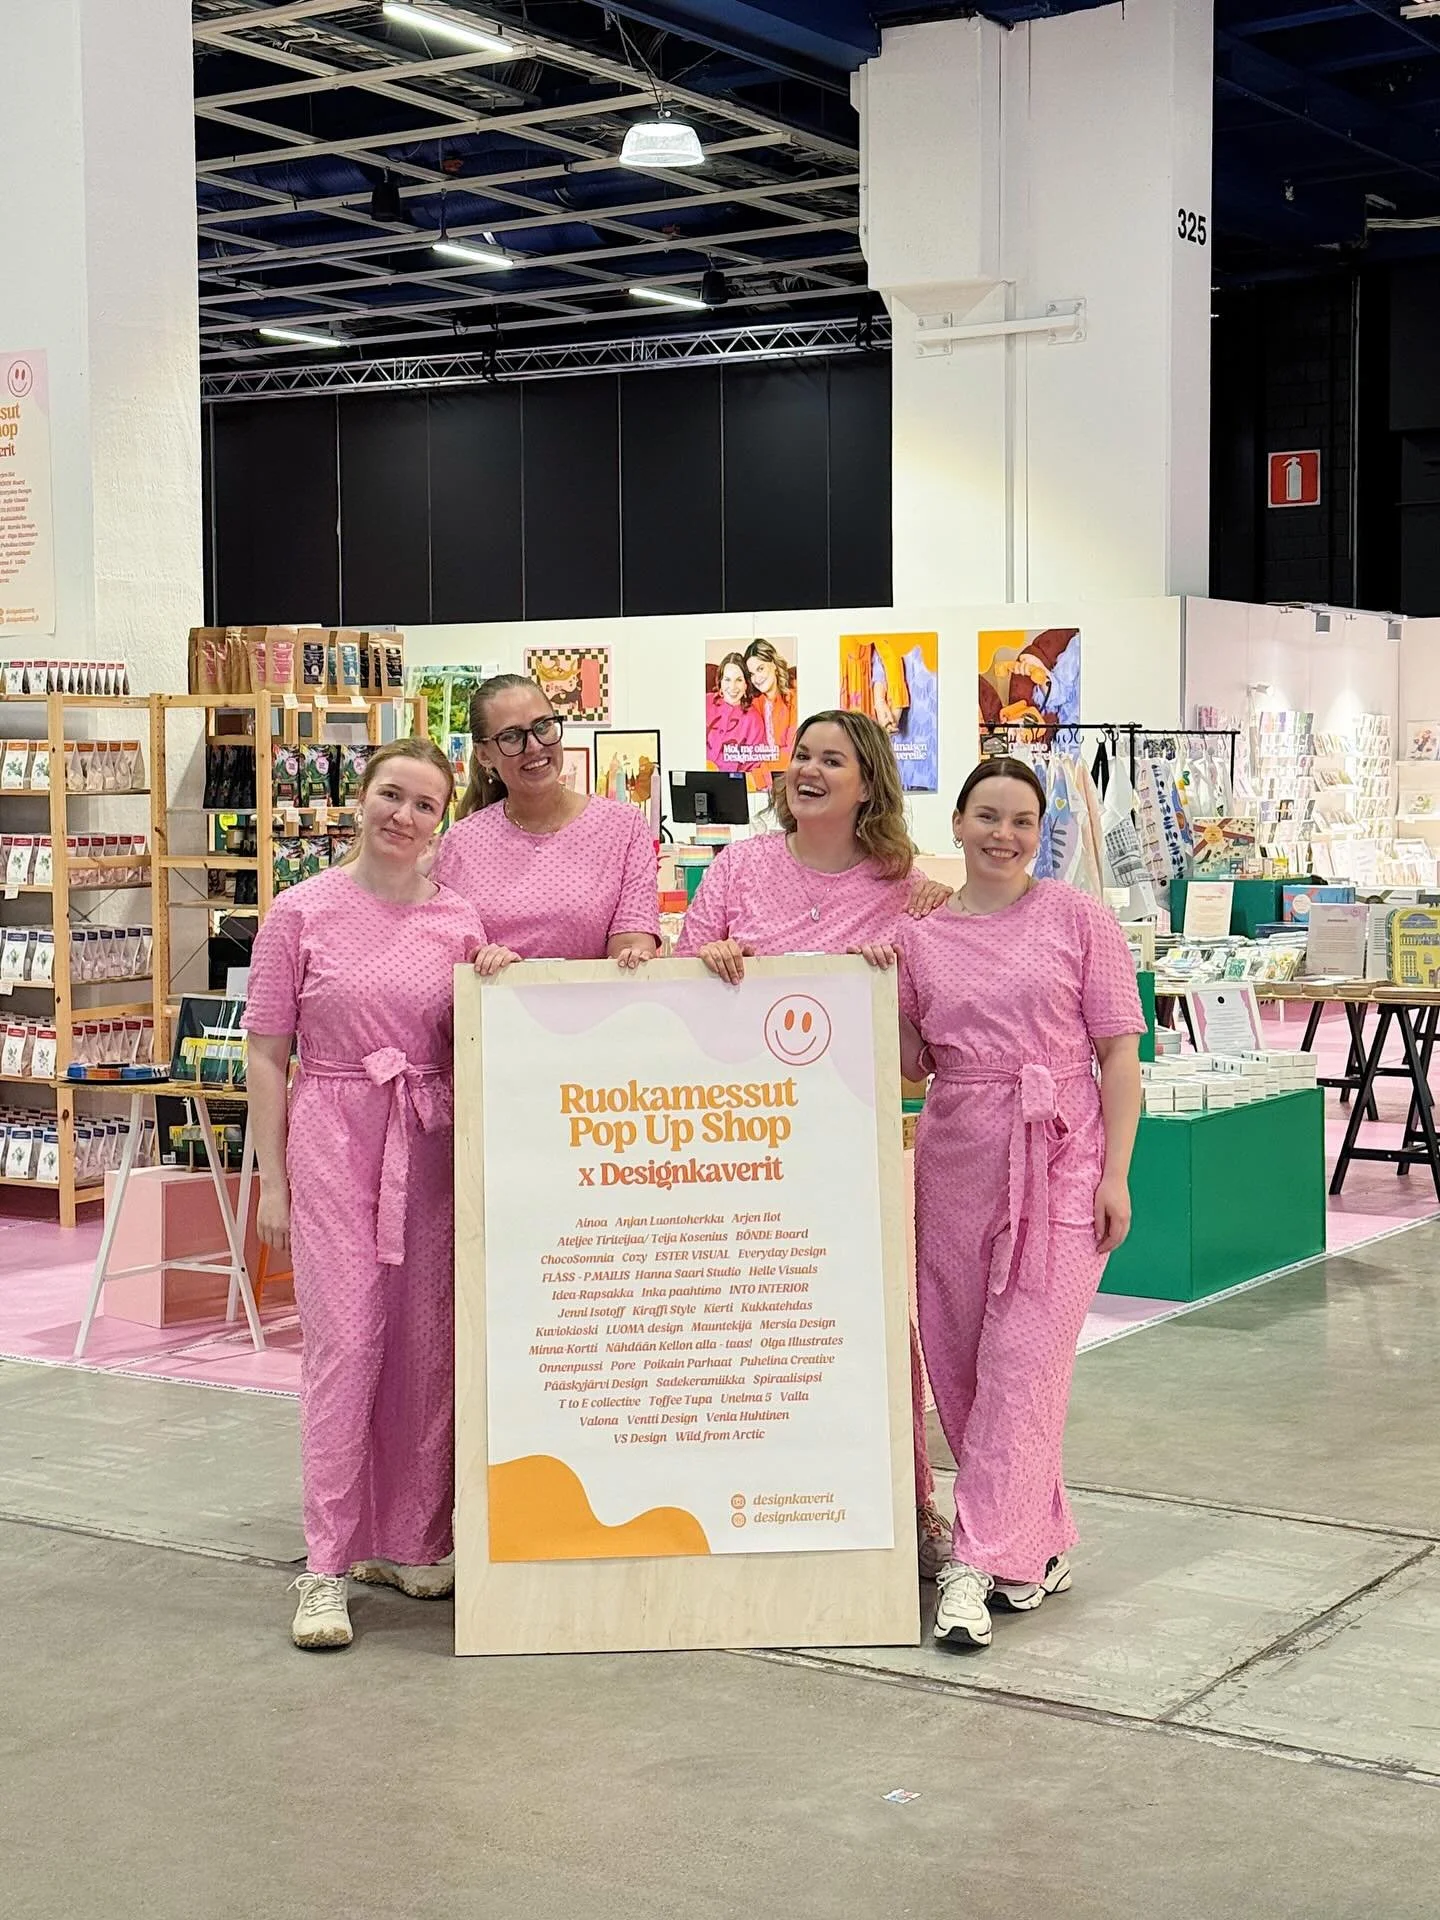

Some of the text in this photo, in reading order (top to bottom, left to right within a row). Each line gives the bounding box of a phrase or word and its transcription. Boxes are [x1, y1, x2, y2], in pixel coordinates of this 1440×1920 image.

[1178, 208, 1206, 245] 325
[560, 1077, 798, 1114] Ruokamessut
[569, 1111, 791, 1153] Pop Up Shop
[578, 1156, 784, 1190] x Designkaverit
[576, 1212, 781, 1229] Ainoa Anjan Luontoherkku Arjen Ilot
[557, 1236, 593, 1248] Ateljee
[652, 1233, 677, 1244] Teija
[680, 1232, 728, 1242] Kosenius
[775, 1229, 809, 1239] Board
[541, 1246, 827, 1264] ChocoSomnia Cozy ESTER VISUAL Everyday Design
[635, 1270, 672, 1279] Hanna
[674, 1268, 704, 1278] Saari
[706, 1266, 741, 1277] Studio
[749, 1266, 776, 1276] Helle
[778, 1264, 818, 1275] Visuals
[552, 1283, 809, 1301] Idea-Rapsakka Inka paahtimo INTO INTERIOR
[558, 1301, 812, 1318] Jenni Isotoff Kiraffi Style Kierti Kukkatehdas
[536, 1325, 598, 1337] Kuviokioski
[606, 1324, 644, 1334] LUOMA
[647, 1322, 683, 1334] design
[760, 1319, 797, 1329] Mersia
[799, 1317, 836, 1329] Design
[529, 1343, 598, 1355] Minna-Kortti
[606, 1342, 656, 1352] Nähdään
[659, 1340, 693, 1351] Kellon
[695, 1340, 717, 1349] alla
[726, 1339, 753, 1348] taas!
[760, 1338, 785, 1349] Olga
[788, 1336, 843, 1347] Illustrates
[539, 1354, 835, 1374] Onnenpussi Pore Poikain Parhaat Puhelina Creative
[544, 1372, 822, 1392] Pääskyjärvi Design Sadekeramiikka Spiraalisipsi
[559, 1391, 809, 1409] T to E collective Toffee Tupa Unelma 5 Valla
[580, 1410, 790, 1426] Valona Ventti Design Venla Huhtinen
[614, 1428, 765, 1444] VS Design Wild from Arctic
[753, 1493, 834, 1507] designkaverit
[754, 1509, 846, 1524] designkaverit.fi
